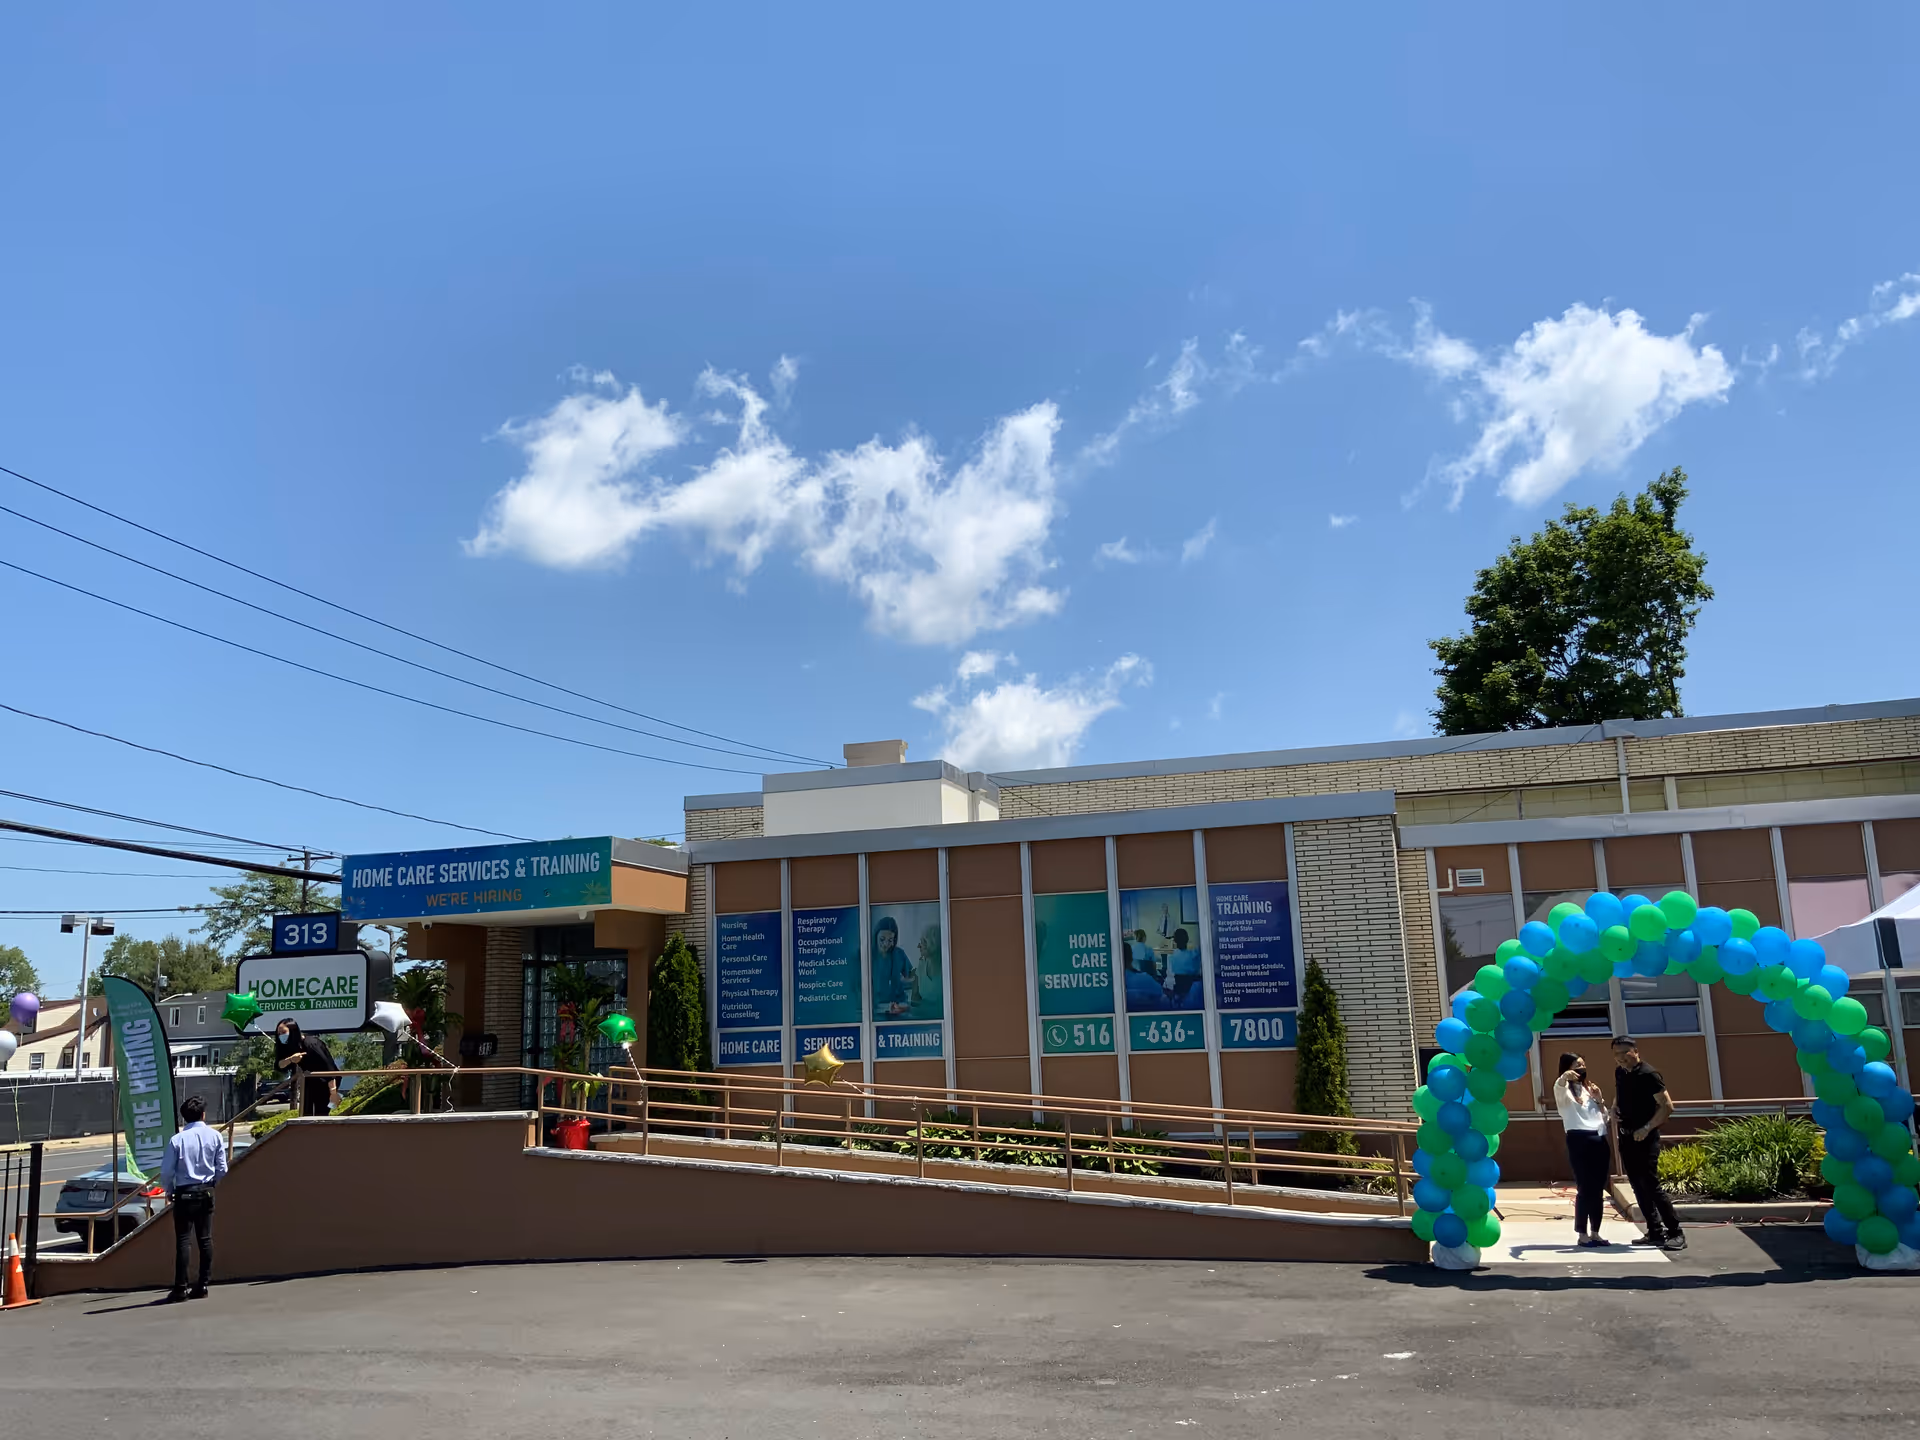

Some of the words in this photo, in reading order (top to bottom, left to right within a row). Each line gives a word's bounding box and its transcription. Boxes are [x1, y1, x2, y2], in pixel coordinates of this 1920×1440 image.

[352, 868, 393, 888] HOME
[397, 864, 435, 886] CARE
[439, 859, 509, 884] SERVICES
[515, 858, 526, 878] &
[531, 852, 600, 877] TRAINING
[426, 892, 468, 907] WE'RE
[474, 889, 522, 904] HIRING
[1217, 901, 1272, 915] TRAINING
[722, 920, 748, 930] Nursing
[798, 916, 837, 926] Respiratory
[284, 922, 328, 945] 313
[798, 925, 826, 934] Therapy
[743, 933, 764, 941] Health
[798, 937, 843, 947] Occupational
[1069, 933, 1106, 949] HOME
[722, 942, 737, 950] Care
[798, 947, 826, 955] Therapy
[722, 955, 751, 963] Personal
[798, 959, 825, 968] Medical
[826, 957, 847, 966] Social
[1072, 953, 1107, 968] CARE
[722, 968, 762, 976] Homemaker
[798, 968, 817, 976] Work
[799, 981, 826, 990] Hospice
[828, 980, 843, 988] Care
[1044, 972, 1108, 989] SERVICES
[249, 975, 358, 998] HOMECARE
[722, 988, 749, 999] Physical
[750, 988, 778, 997] Therapy
[799, 994, 830, 1003] Pediatric
[831, 993, 847, 1001] Care
[300, 1001, 306, 1009] &
[722, 1002, 752, 1010] Nutrition
[722, 1010, 760, 1019] Counseling
[1073, 1023, 1110, 1046] 516
[1230, 1018, 1284, 1042] 7800
[878, 1034, 886, 1048] &
[888, 1033, 940, 1047] TRAINING
[720, 1041, 749, 1055] HOME
[752, 1040, 780, 1053] CARE
[121, 1018, 159, 1096] HIRING
[133, 1098, 164, 1172] WE'RE
